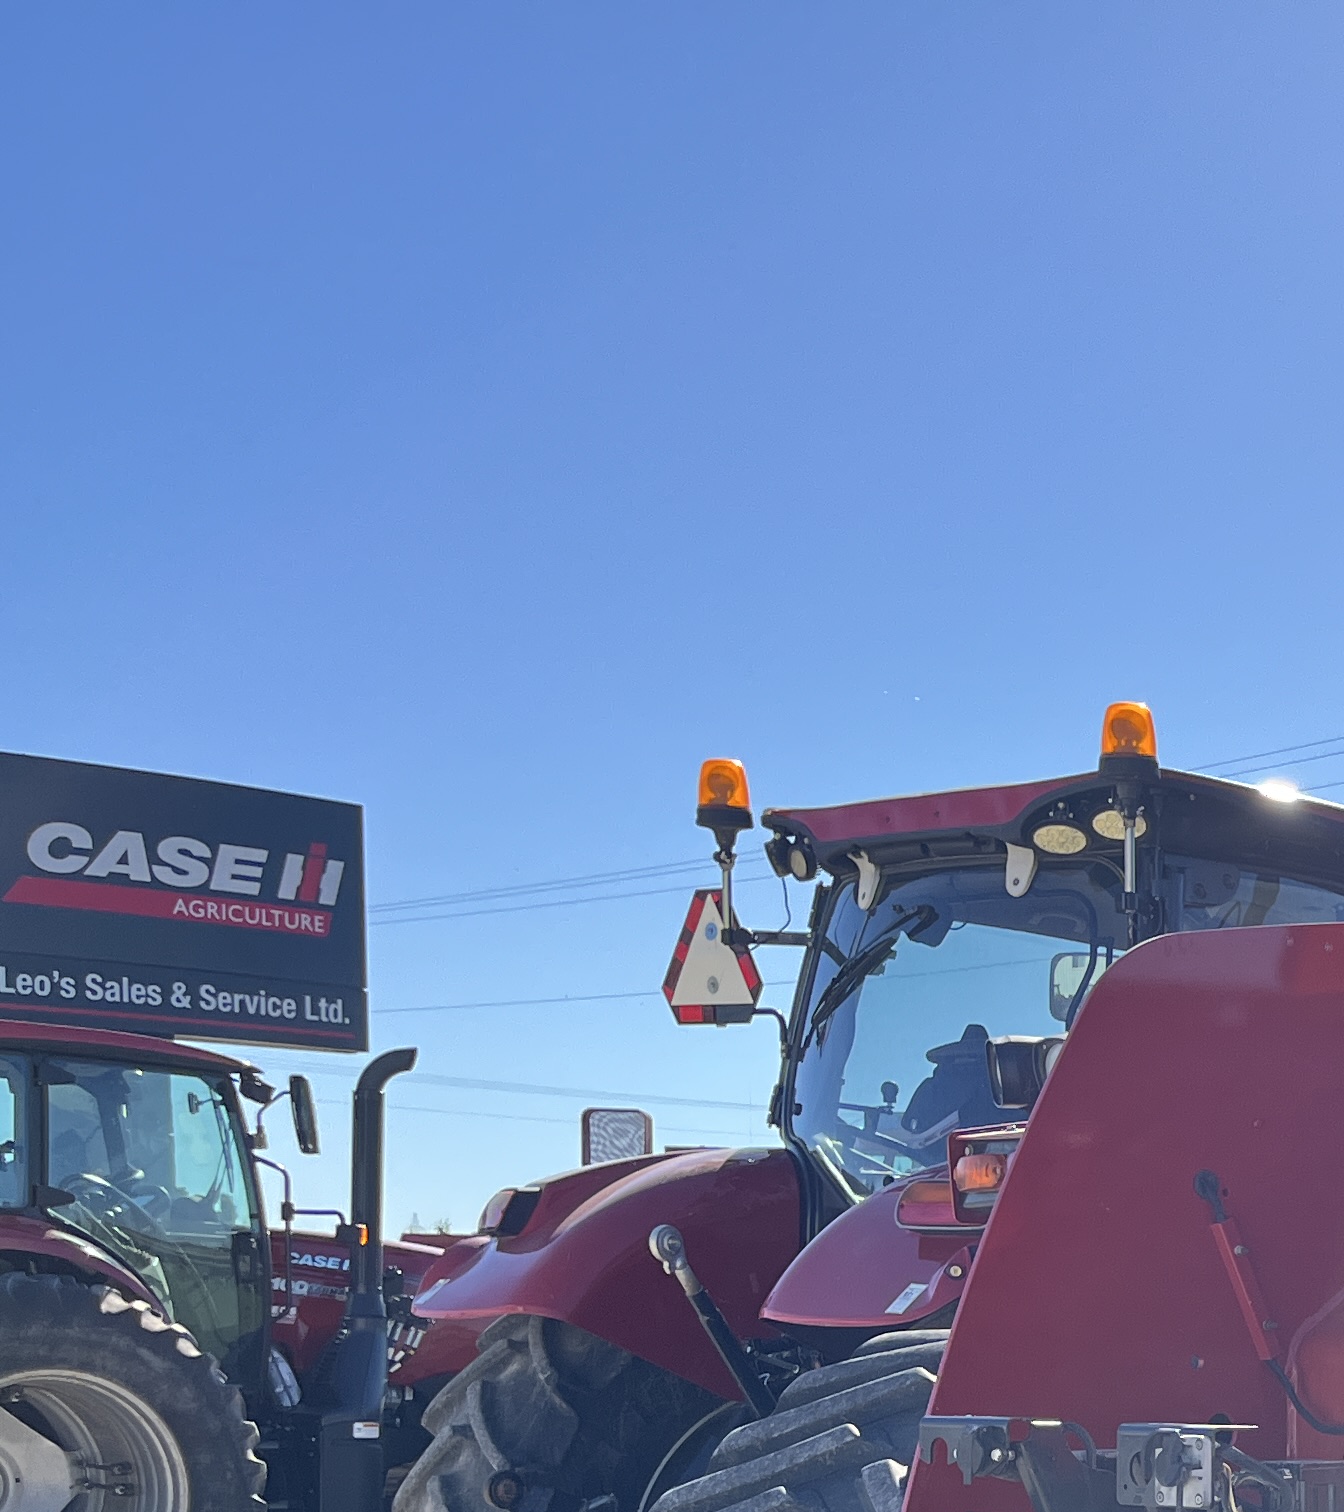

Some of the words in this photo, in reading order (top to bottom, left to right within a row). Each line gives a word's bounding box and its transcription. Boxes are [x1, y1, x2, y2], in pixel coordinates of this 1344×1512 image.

[26, 820, 269, 897] CASE
[277, 842, 345, 906] IH
[172, 898, 326, 934] AGRICULTURE
[0, 965, 77, 999] Leo's
[85, 972, 163, 1006] Sales
[170, 981, 192, 1009] &
[198, 983, 297, 1020] Service
[303, 994, 350, 1025] Ltd.
